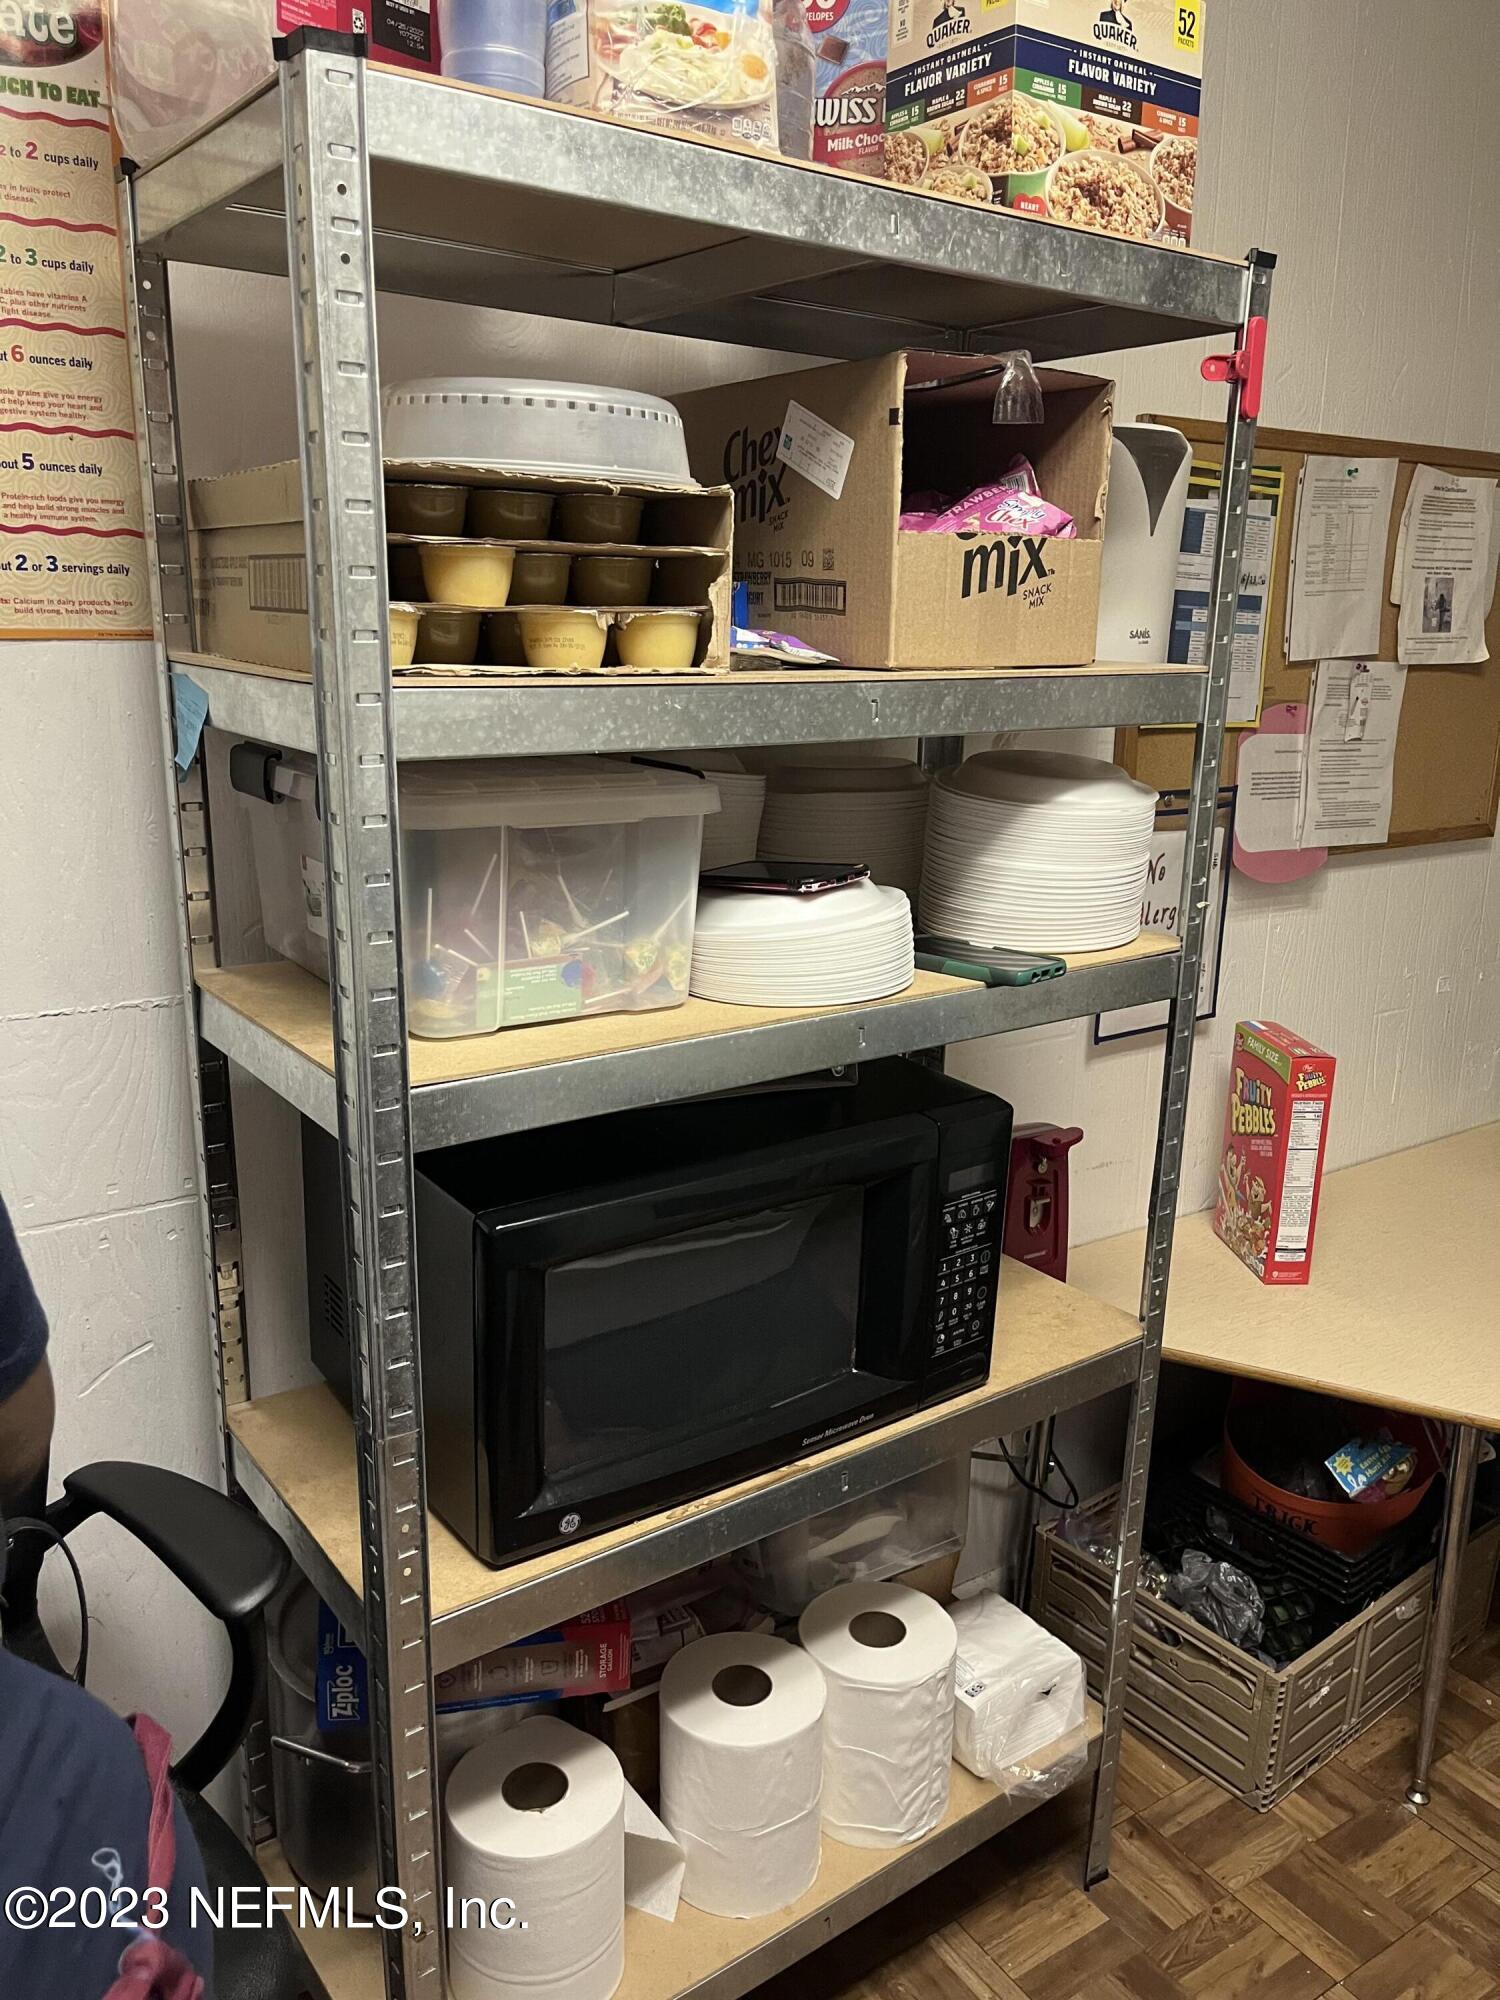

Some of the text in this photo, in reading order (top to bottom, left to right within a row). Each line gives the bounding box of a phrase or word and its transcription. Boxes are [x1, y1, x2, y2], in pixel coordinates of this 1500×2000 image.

[926, 19, 971, 48] QUAKER
[1178, 8, 1196, 39] 52
[1093, 23, 1137, 51] QUAKER
[914, 44, 981, 76] INSTANT OATMEAL
[1079, 50, 1148, 76] INSTANT OATMEAL
[904, 52, 993, 97] FLAVOR VARIETY
[999, 74, 1008, 86] 15
[1068, 58, 1157, 97] FLAVOR VARIETY
[37, 81, 62, 102] TO
[66, 86, 101, 108] EAT
[956, 88, 966, 101] 22
[1058, 83, 1067, 95] 15
[814, 97, 877, 127] WISS
[911, 105, 920, 117] 15
[1122, 100, 1132, 113] 22
[1178, 117, 1187, 128] 15
[10, 141, 99, 171] to 2 cups daily
[827, 139, 853, 153] Milk
[42, 189, 71, 198] protect
[1020, 201, 1040, 212] HEART
[10, 248, 94, 275] to 3 cups daily
[27, 290, 44, 298] have
[47, 292, 79, 302] vitamins
[29, 301, 49, 309] other
[51, 304, 86, 312] nutrients
[11, 345, 93, 371] 6 ounces daily
[8, 398, 24, 406] help
[27, 399, 45, 408] keep
[67, 402, 87, 410] heart
[43, 391, 59, 399] give
[30, 410, 57, 419] system
[0, 453, 103, 477] out 5 ounces daily
[735, 468, 786, 523] mix
[15, 554, 130, 576] 2 or 3 servings daily
[801, 550, 815, 568] 09
[962, 536, 1048, 599] mix
[13, 597, 45, 605] Calcium
[1023, 583, 1053, 601] SNACK
[1029, 596, 1045, 609] MIX
[1147, 853, 1166, 885] No
[1247, 1036, 1279, 1064] FAMILY SIZE
[1296, 1077, 1326, 1092] PEBBLES
[1231, 1092, 1276, 1138] PEBBLES
[600, 1643, 608, 1678] STORAGE
[331, 1665, 359, 1717] Ziploc
